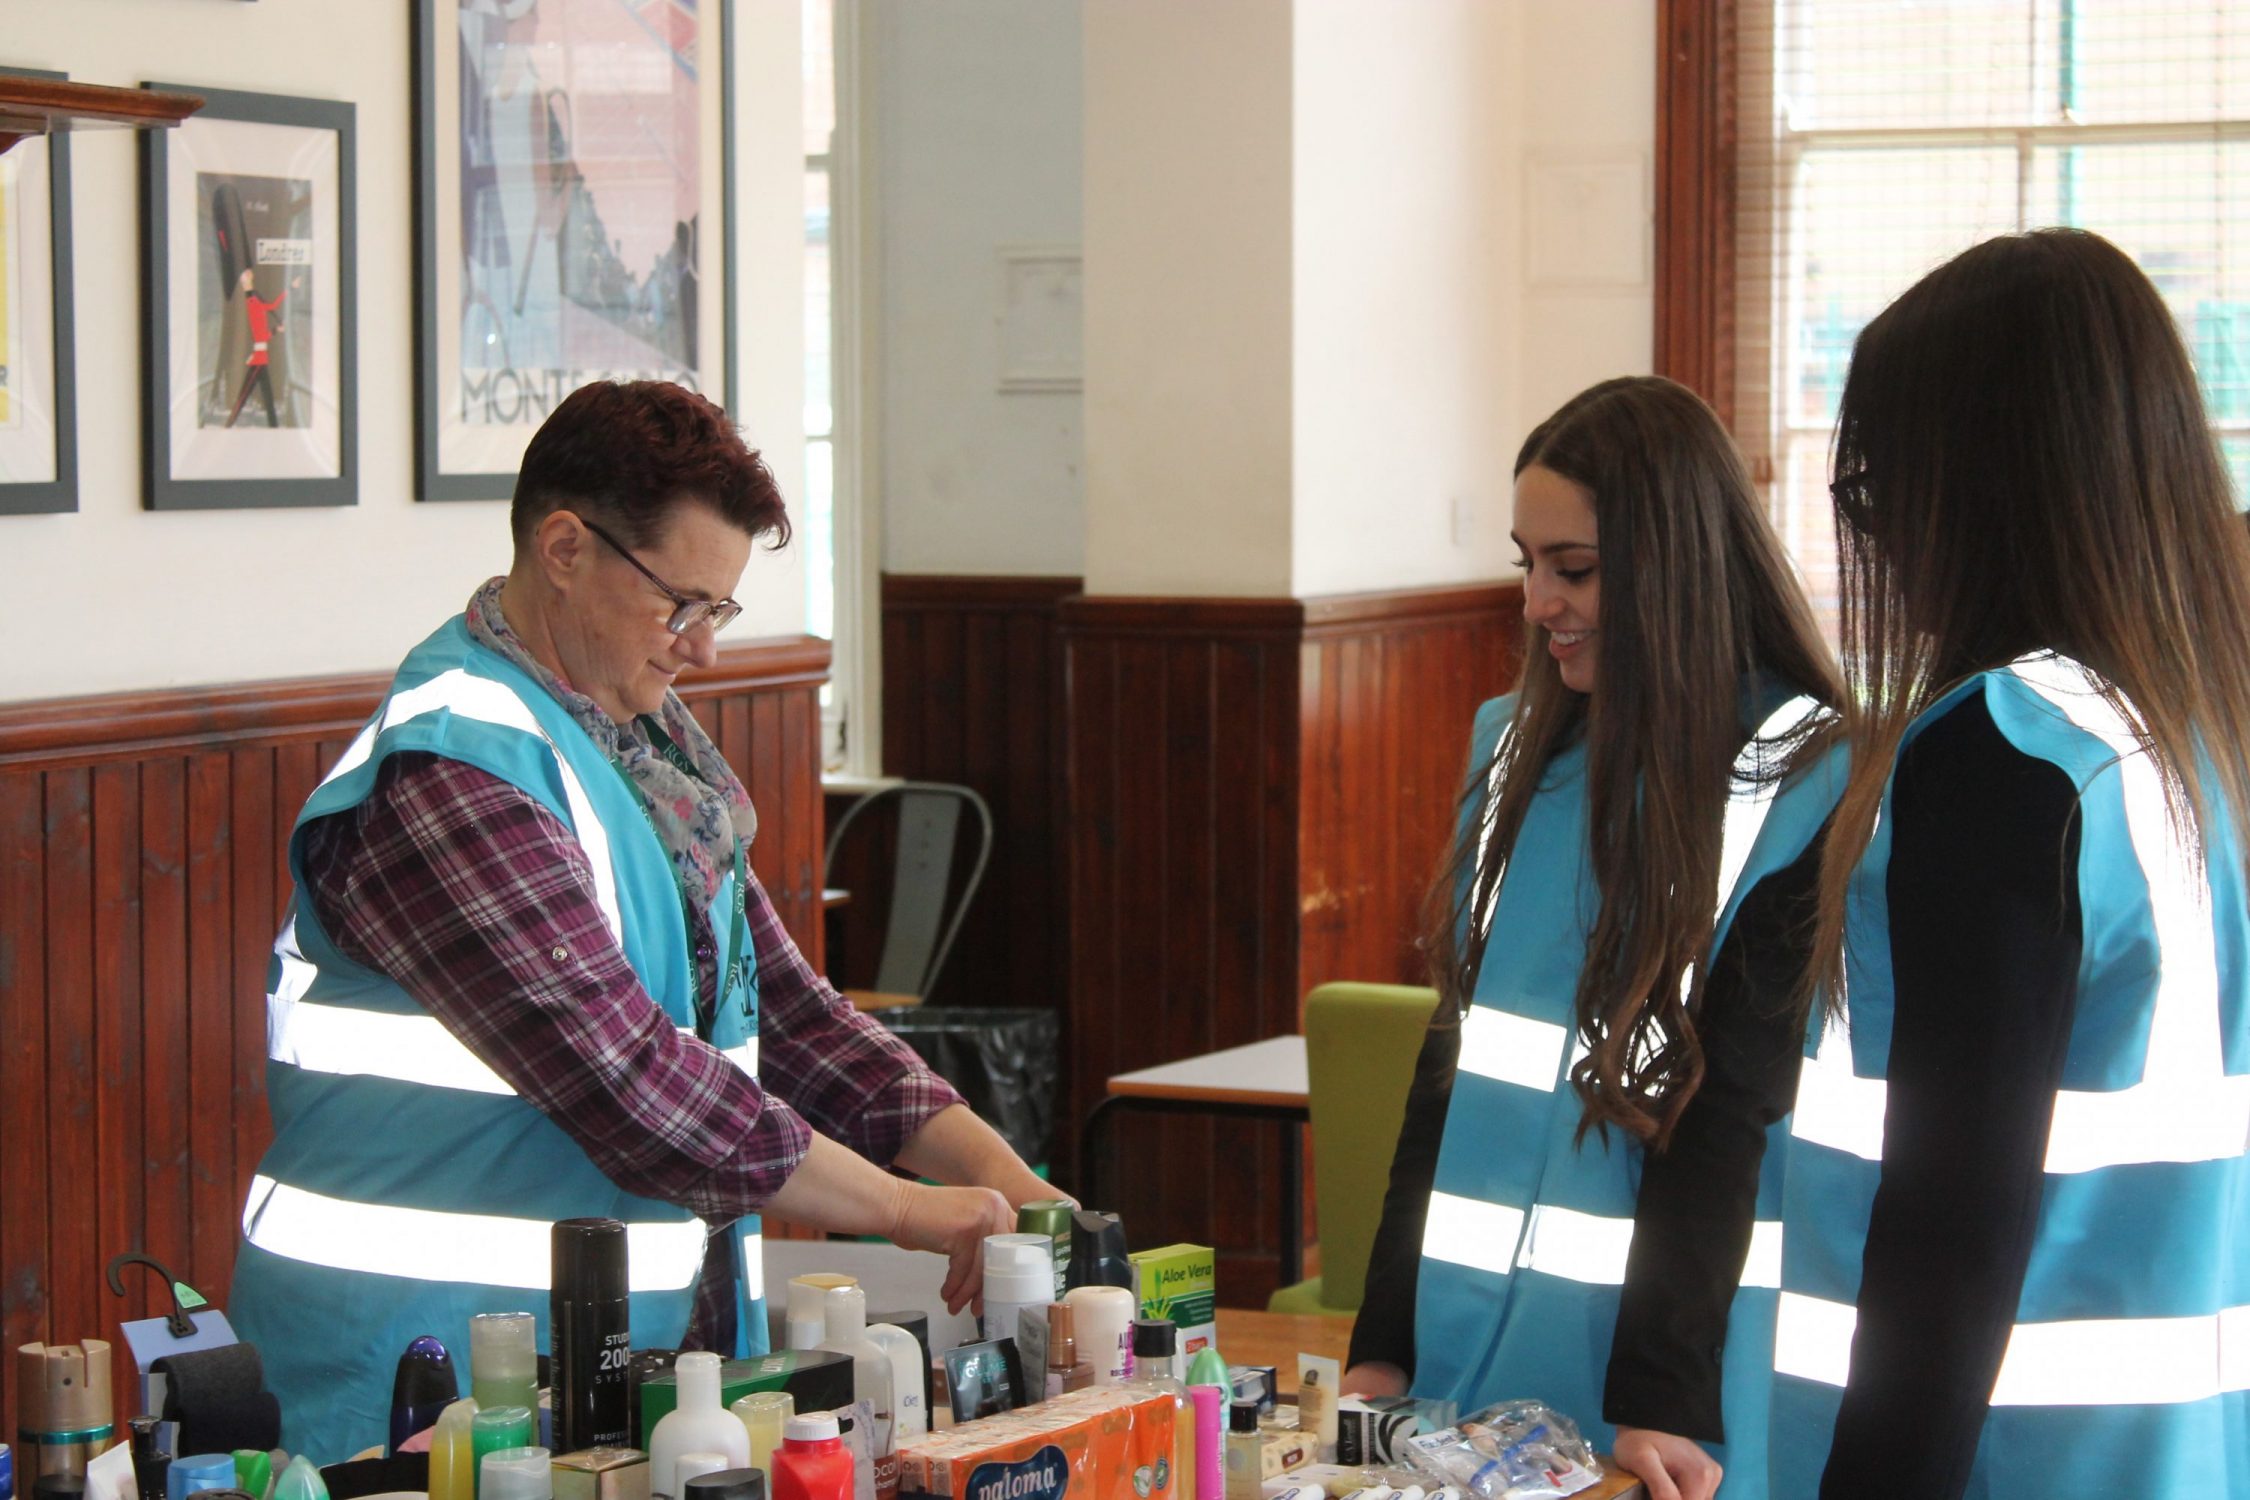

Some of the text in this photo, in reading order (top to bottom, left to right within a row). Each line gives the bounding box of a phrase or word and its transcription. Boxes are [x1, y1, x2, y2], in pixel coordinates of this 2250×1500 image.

[1162, 1264, 1213, 1284] Aloe Vera
[978, 1464, 1056, 1500] paloma
